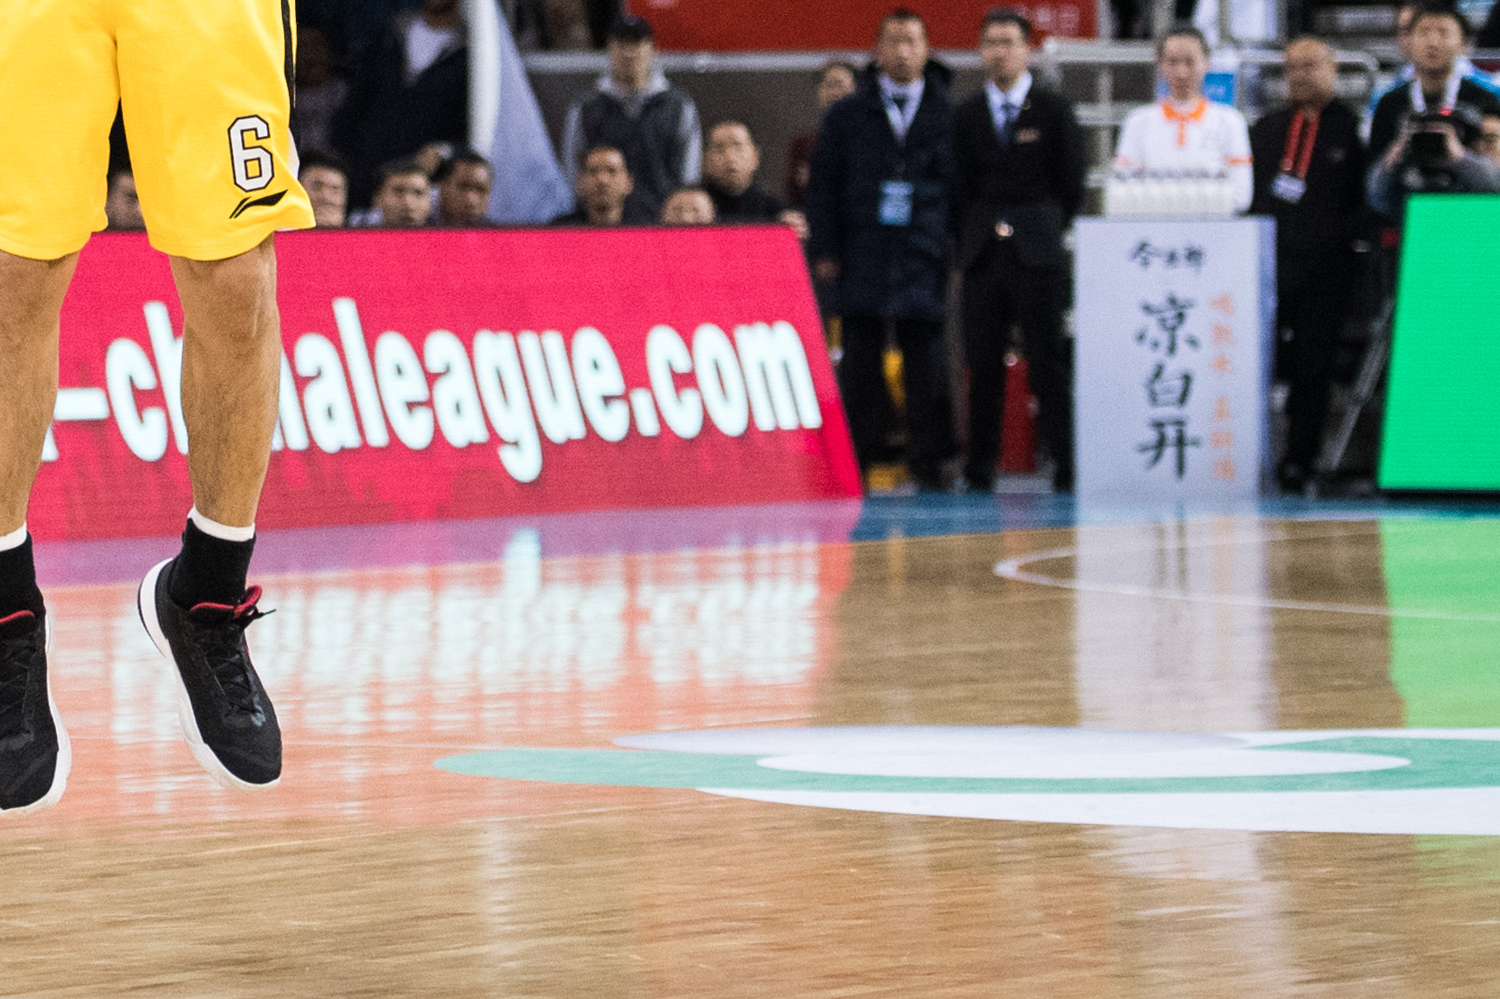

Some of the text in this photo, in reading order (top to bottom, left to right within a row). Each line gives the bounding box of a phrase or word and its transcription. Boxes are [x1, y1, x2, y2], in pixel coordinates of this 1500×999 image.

[227, 114, 275, 193] 6
[1134, 292, 1202, 481] 凉白开
